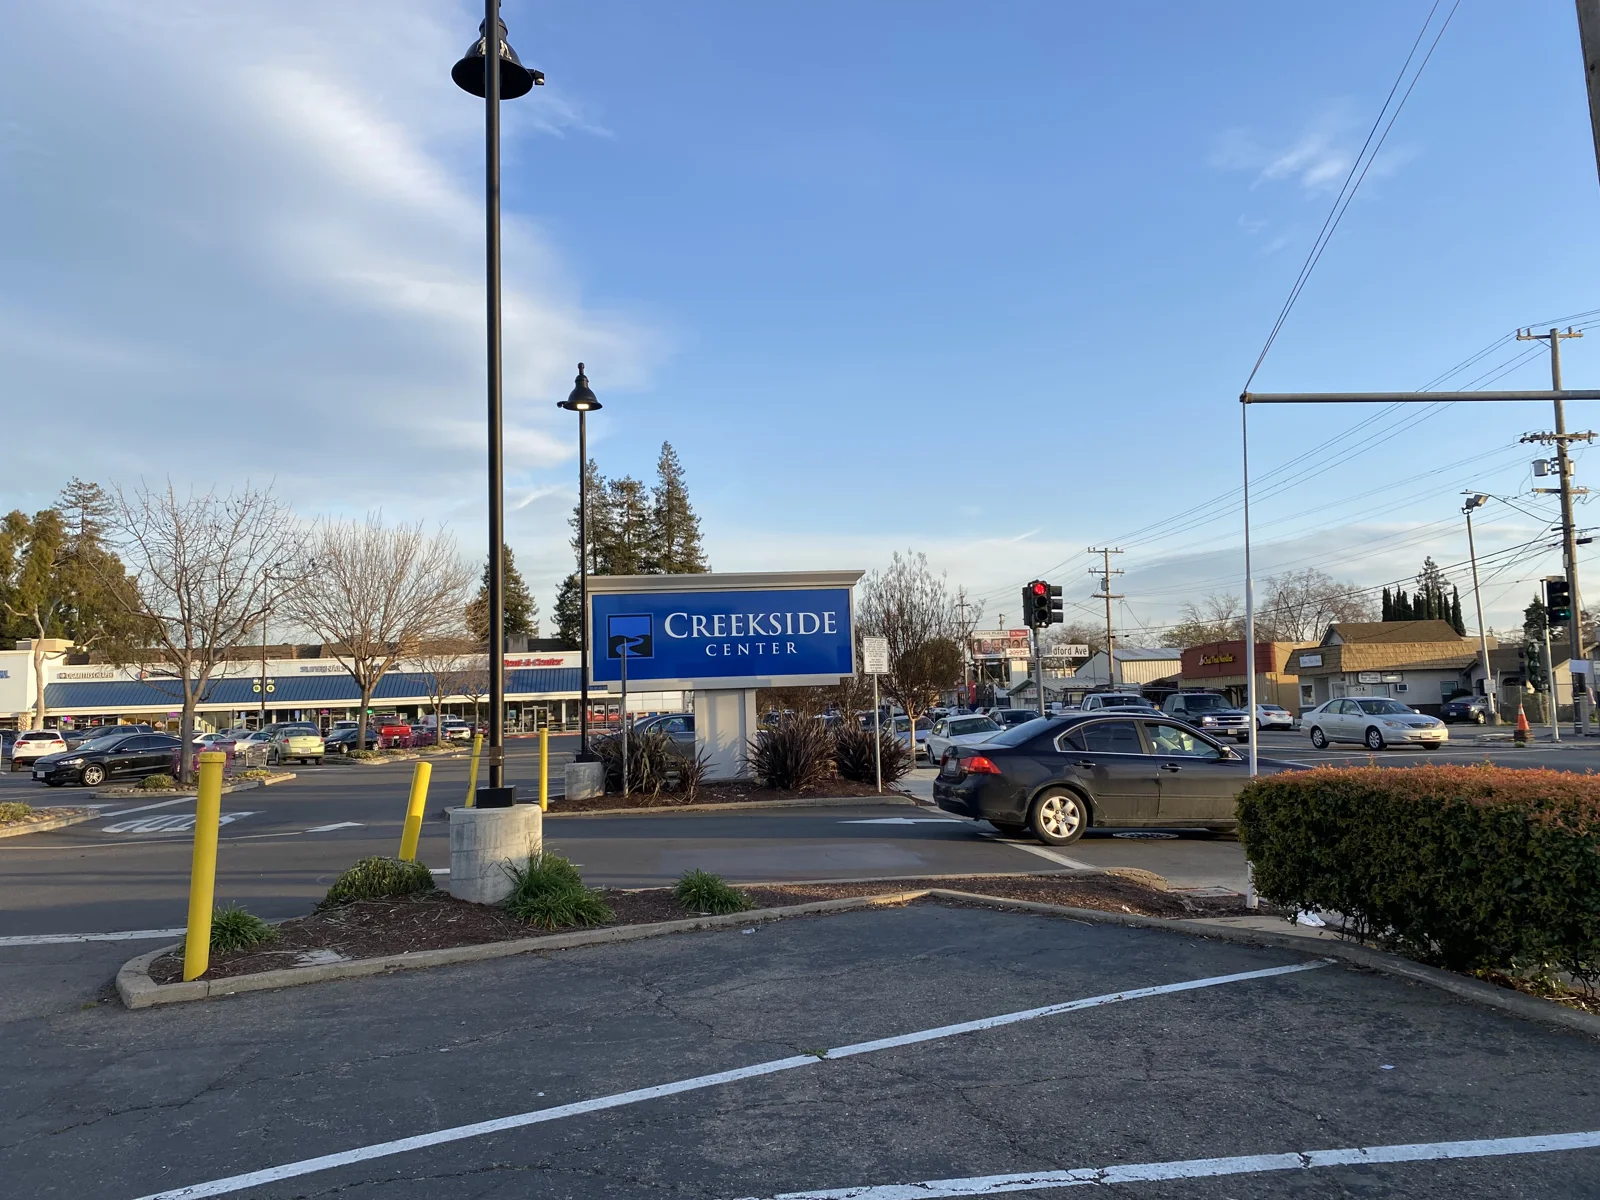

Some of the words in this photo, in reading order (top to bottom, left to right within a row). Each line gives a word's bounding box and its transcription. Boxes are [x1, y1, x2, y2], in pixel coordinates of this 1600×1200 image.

[664, 611, 838, 639] CREEKSIDE
[705, 642, 798, 657] CENTER
[1049, 646, 1072, 656] dford
[1074, 646, 1088, 656] Ave
